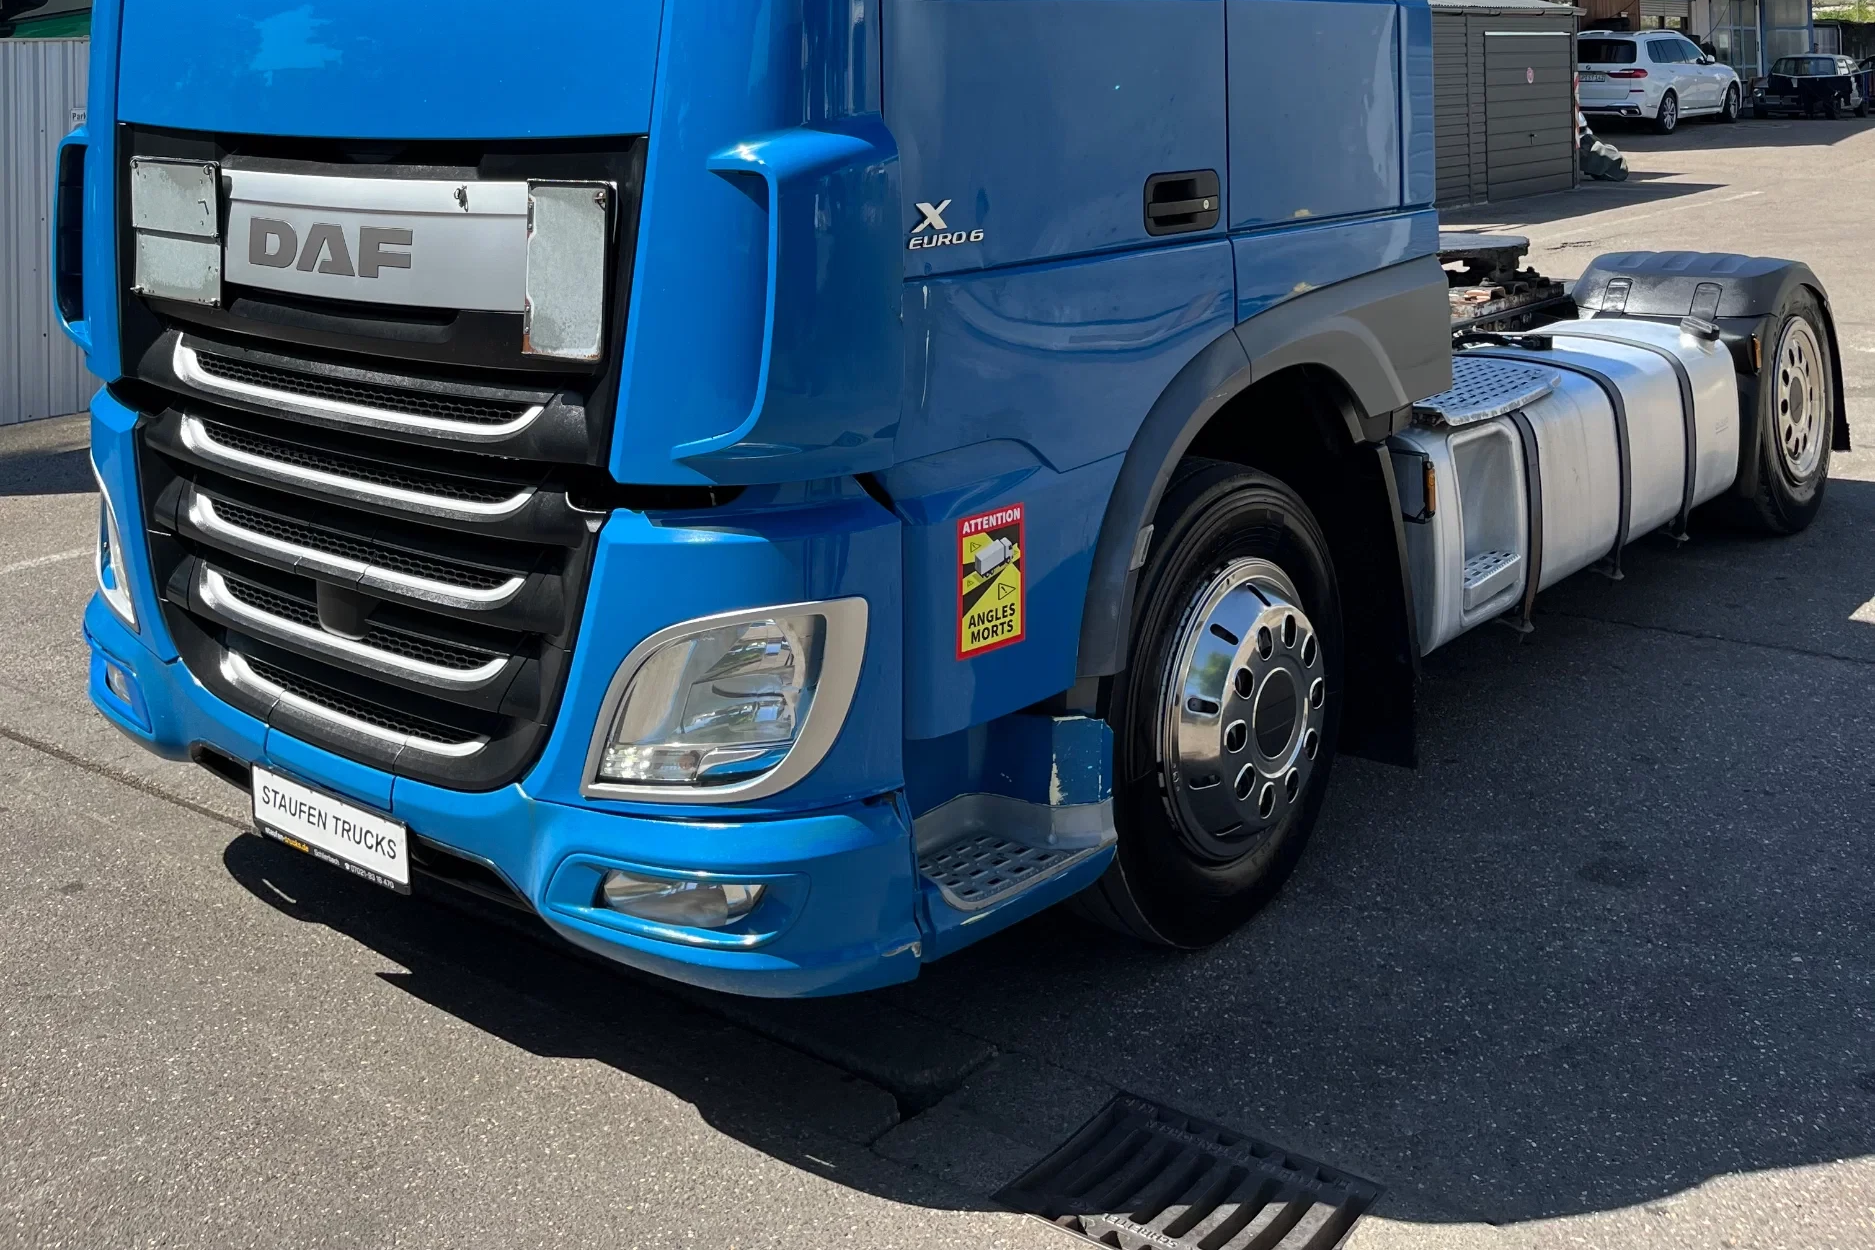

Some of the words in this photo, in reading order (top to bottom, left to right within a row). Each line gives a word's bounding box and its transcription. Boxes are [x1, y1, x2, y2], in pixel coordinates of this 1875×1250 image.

[910, 199, 952, 233] X
[248, 216, 413, 279] DAF
[908, 231, 967, 250] EURO
[969, 229, 984, 242] 6
[962, 507, 1021, 535] ATTENTION
[968, 602, 1016, 629] ANGLES
[971, 619, 1014, 644] MORTS
[262, 785, 328, 831] STAUFEN
[332, 814, 397, 860] TRUCKS
